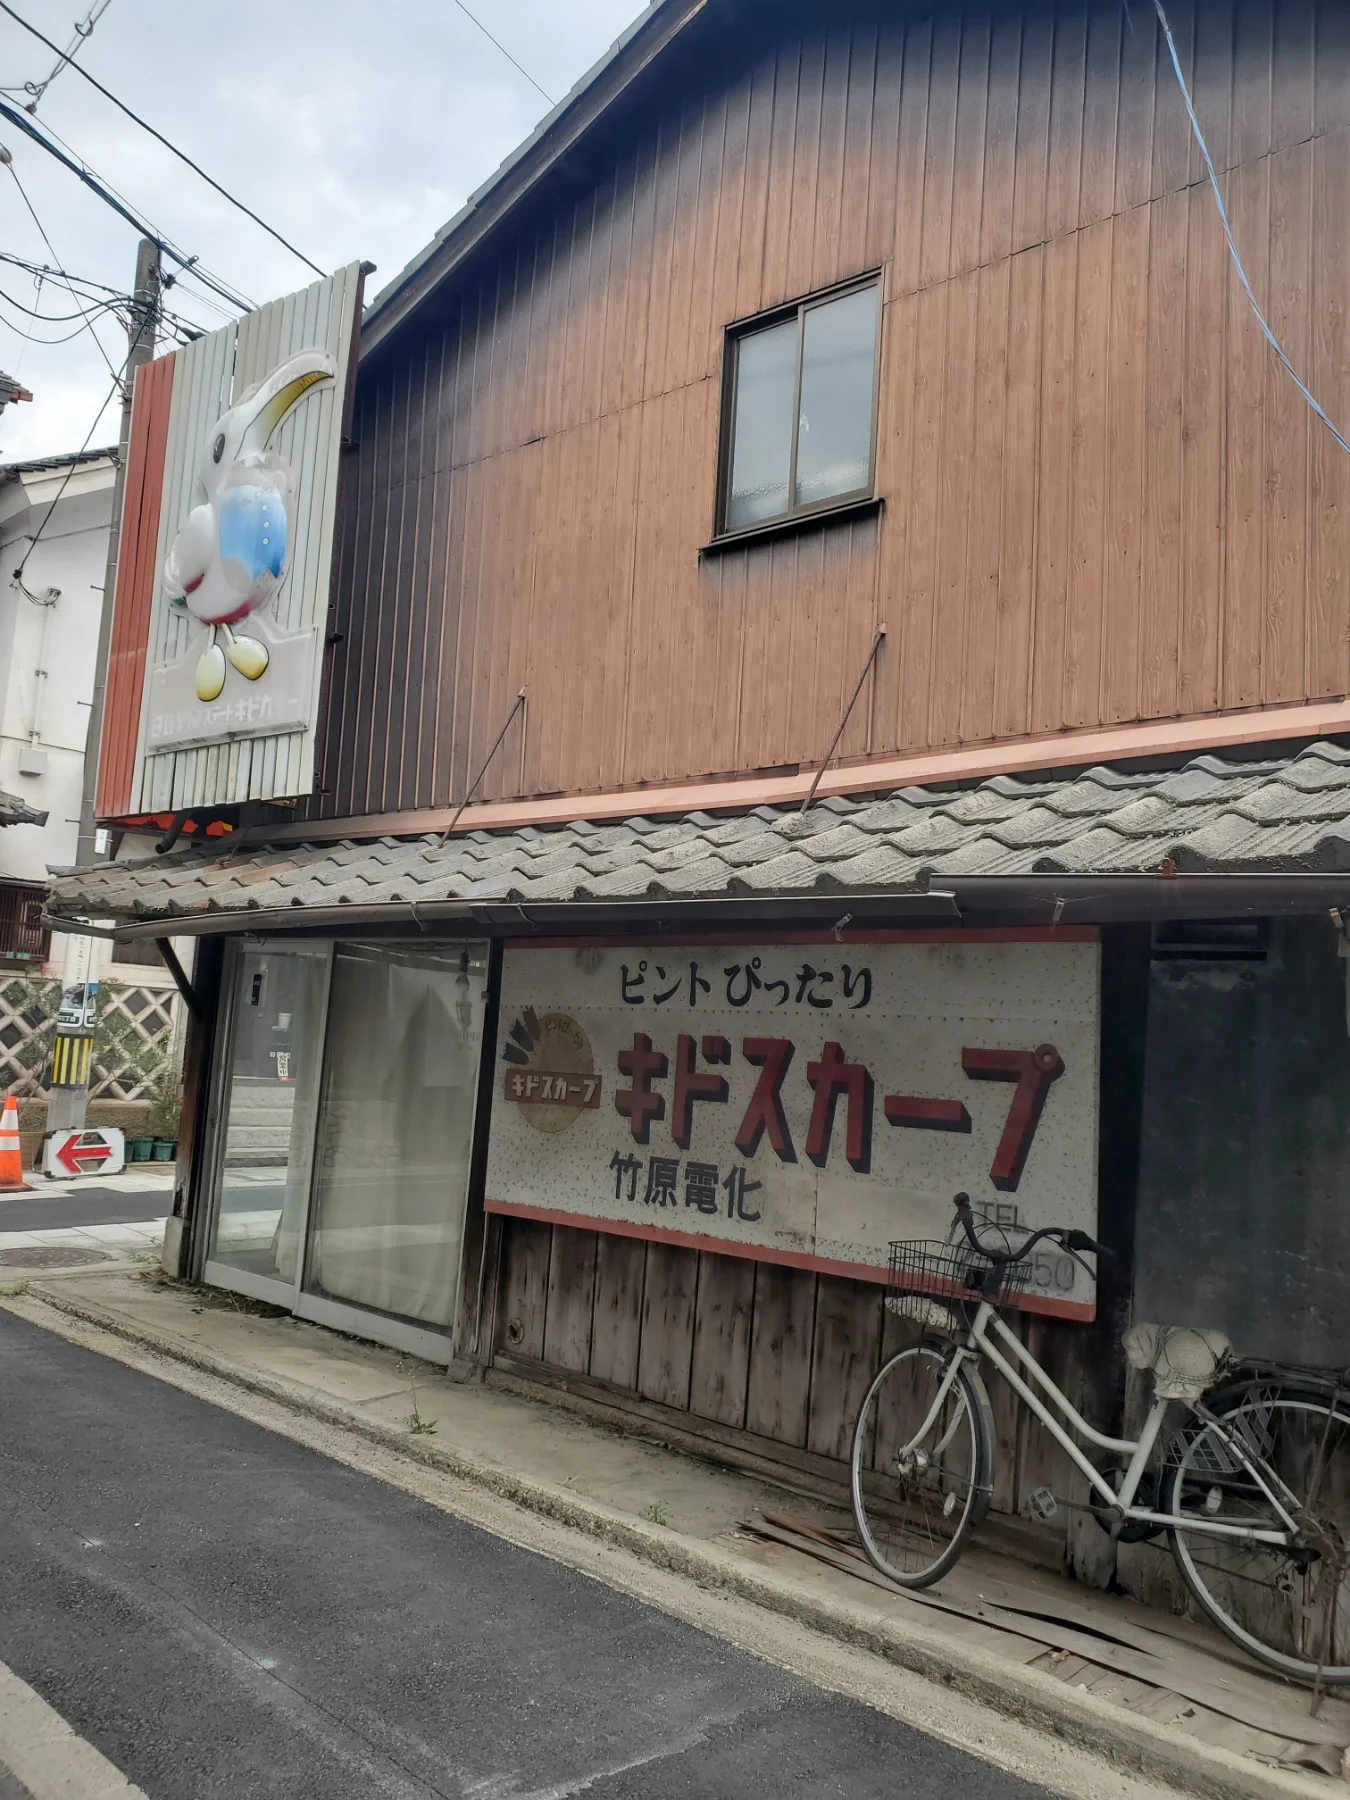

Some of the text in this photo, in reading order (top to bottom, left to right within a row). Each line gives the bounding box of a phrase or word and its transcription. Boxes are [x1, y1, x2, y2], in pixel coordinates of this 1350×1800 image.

[512, 1074, 599, 1103] キドスカープ
[614, 1031, 1066, 1193] キドスカープ
[608, 1150, 763, 1222] 竹原電化
[976, 1200, 1029, 1235] TEL
